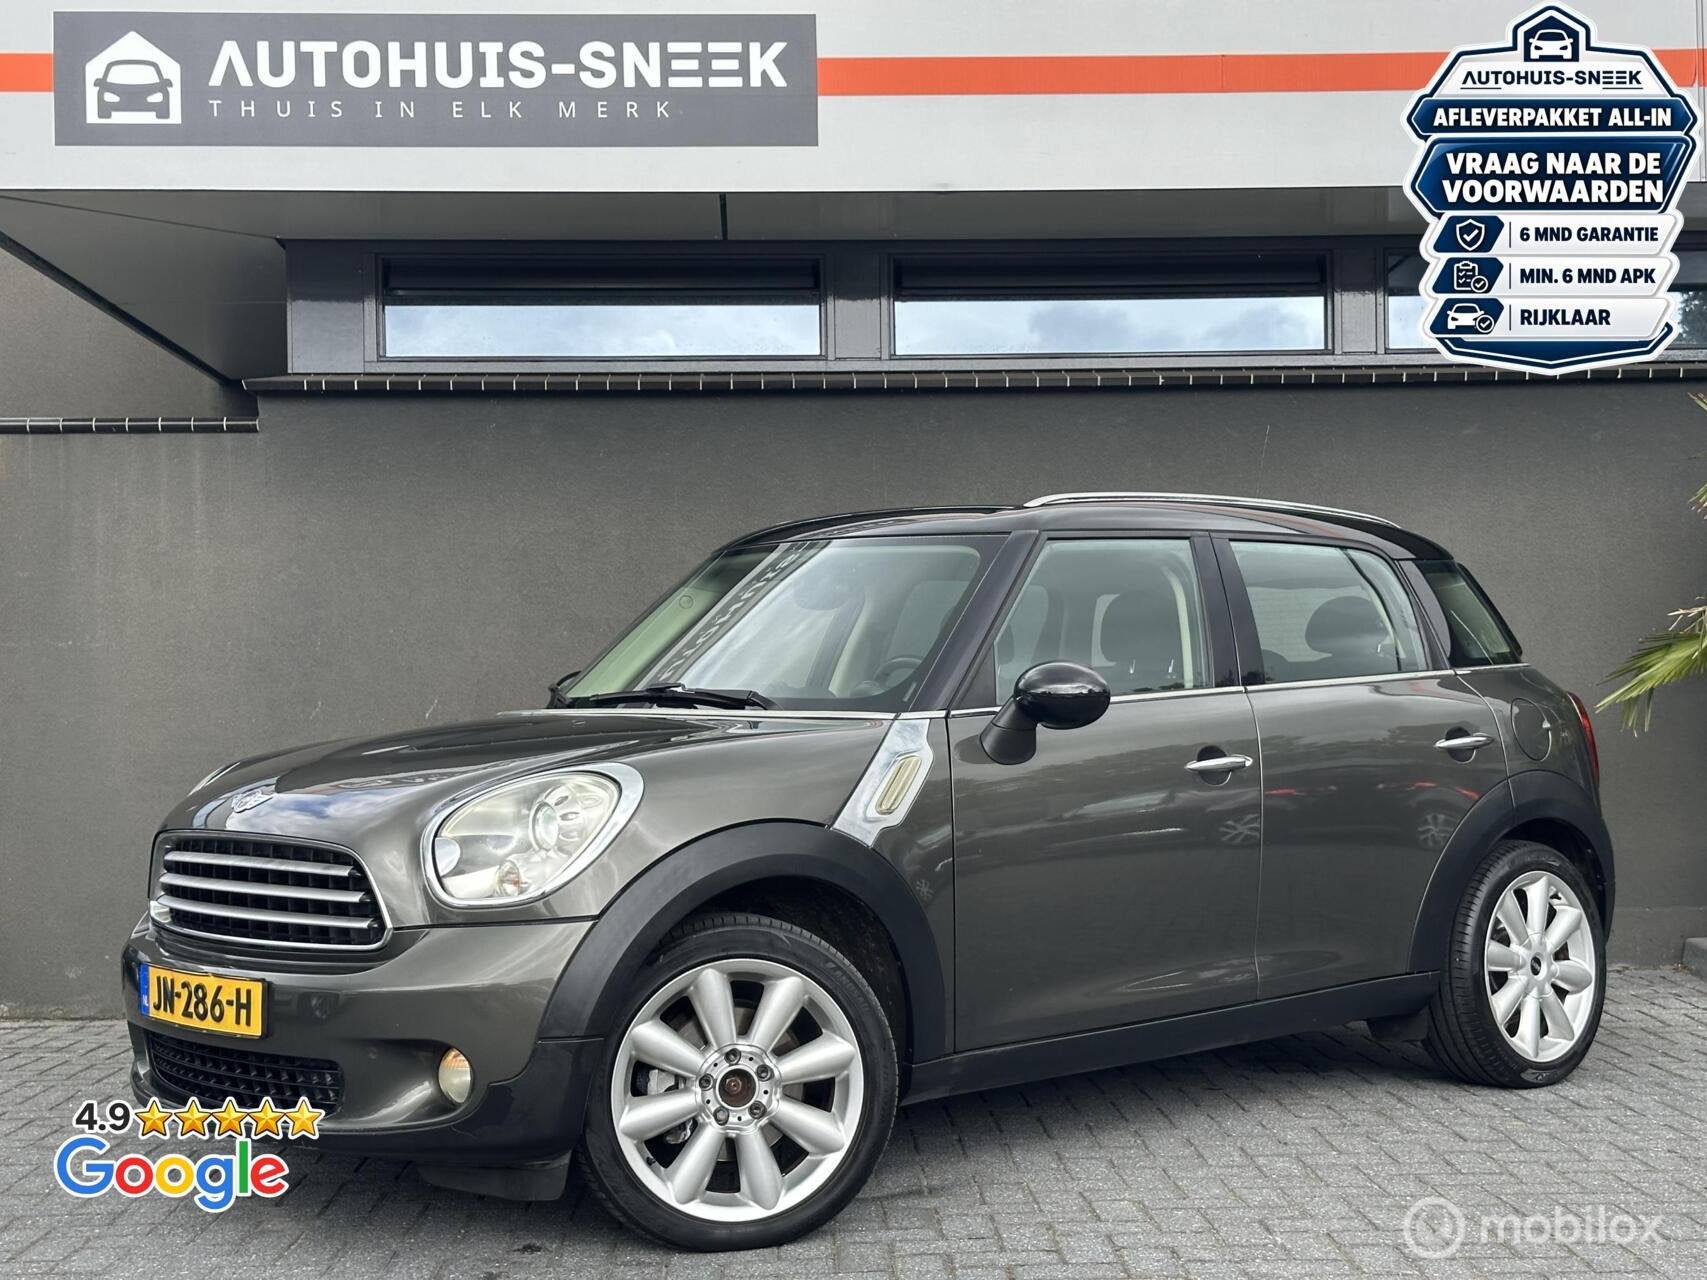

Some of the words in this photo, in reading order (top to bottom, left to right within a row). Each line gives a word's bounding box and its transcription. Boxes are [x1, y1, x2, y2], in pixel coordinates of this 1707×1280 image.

[208, 40, 788, 89] AUTOHUIS-SNEEK
[209, 101, 344, 118] THUIS
[375, 101, 415, 118] IN
[452, 101, 522, 118] ELK
[560, 101, 671, 118] MERK
[153, 975, 252, 1027] JN-286-H
